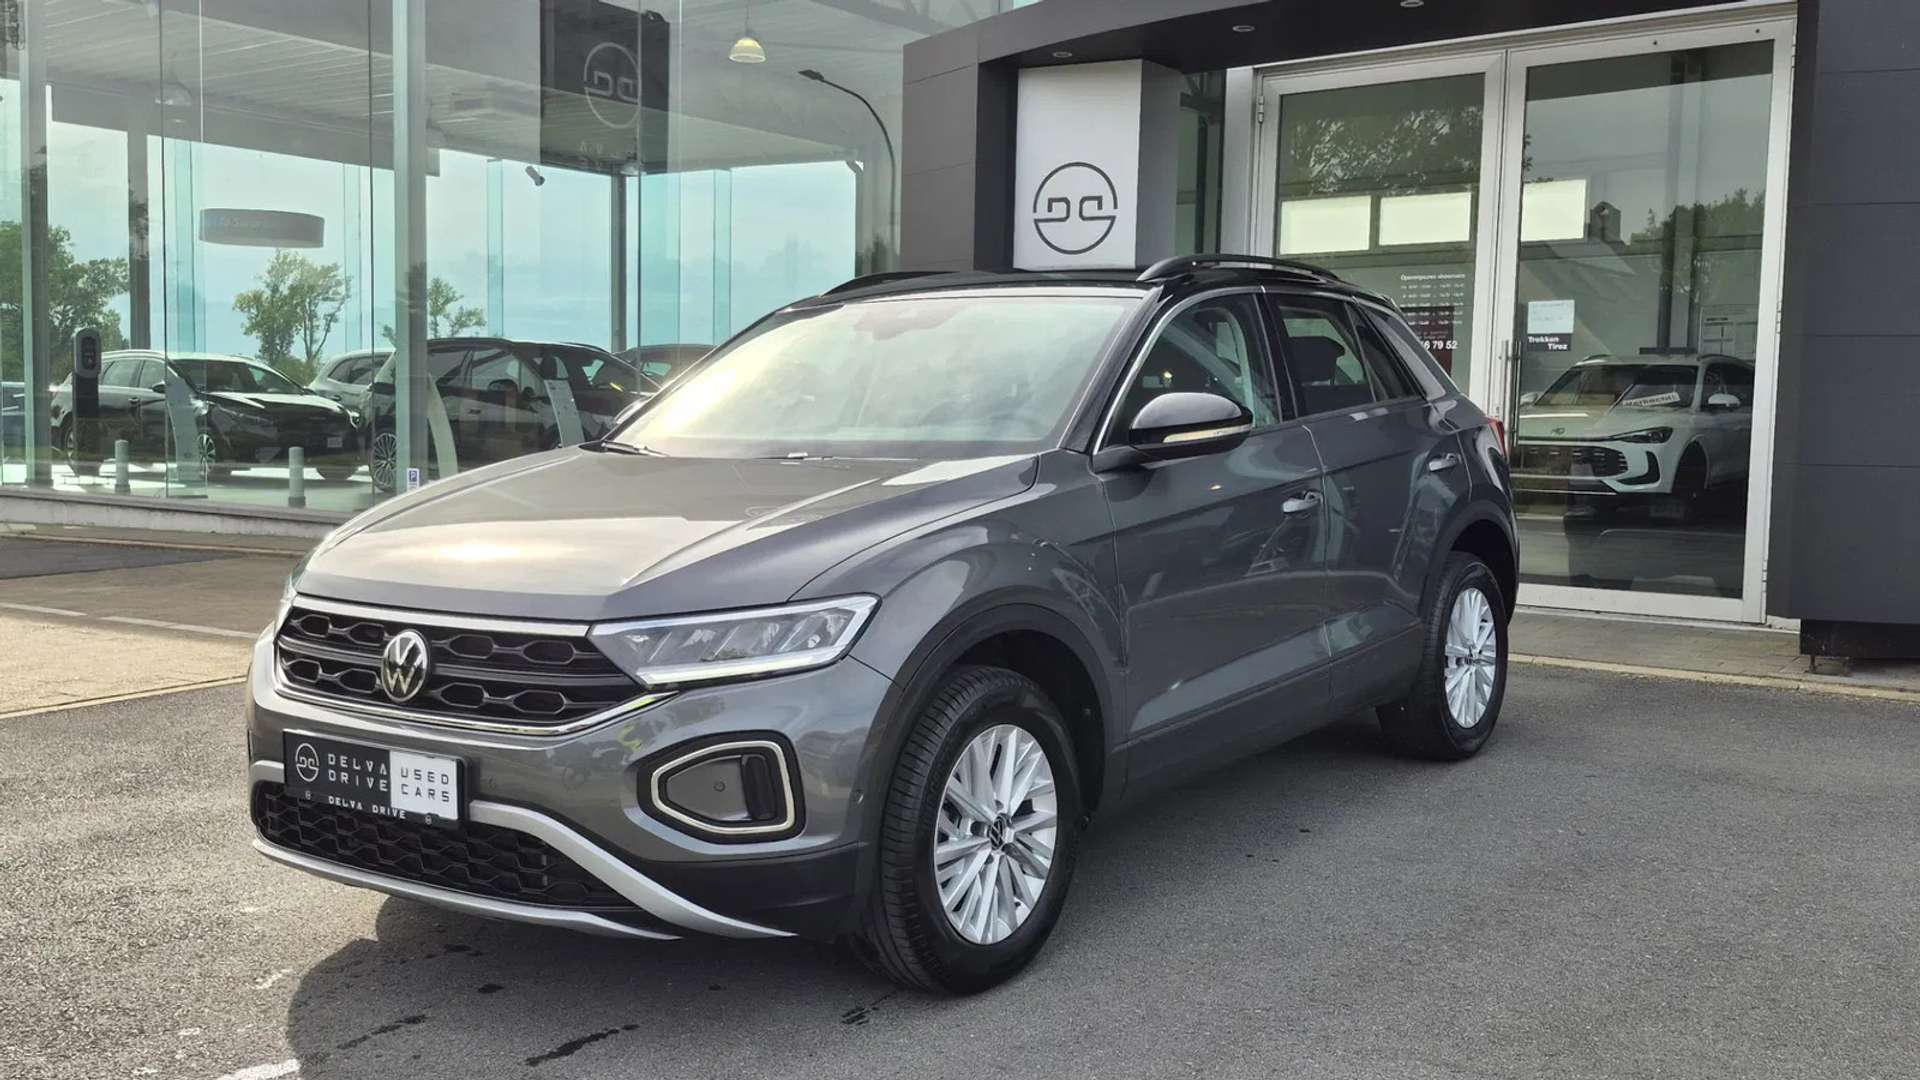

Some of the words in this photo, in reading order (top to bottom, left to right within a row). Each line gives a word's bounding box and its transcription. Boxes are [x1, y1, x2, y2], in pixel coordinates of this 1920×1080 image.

[1432, 340, 1444, 350] 79
[1445, 340, 1458, 350] 52
[328, 753, 387, 775] DELVA
[328, 769, 388, 792] DRIVE
[401, 767, 449, 785] USED
[401, 784, 450, 802] CARS
[328, 795, 363, 810] DELVA
[372, 804, 406, 819] DRIVE
